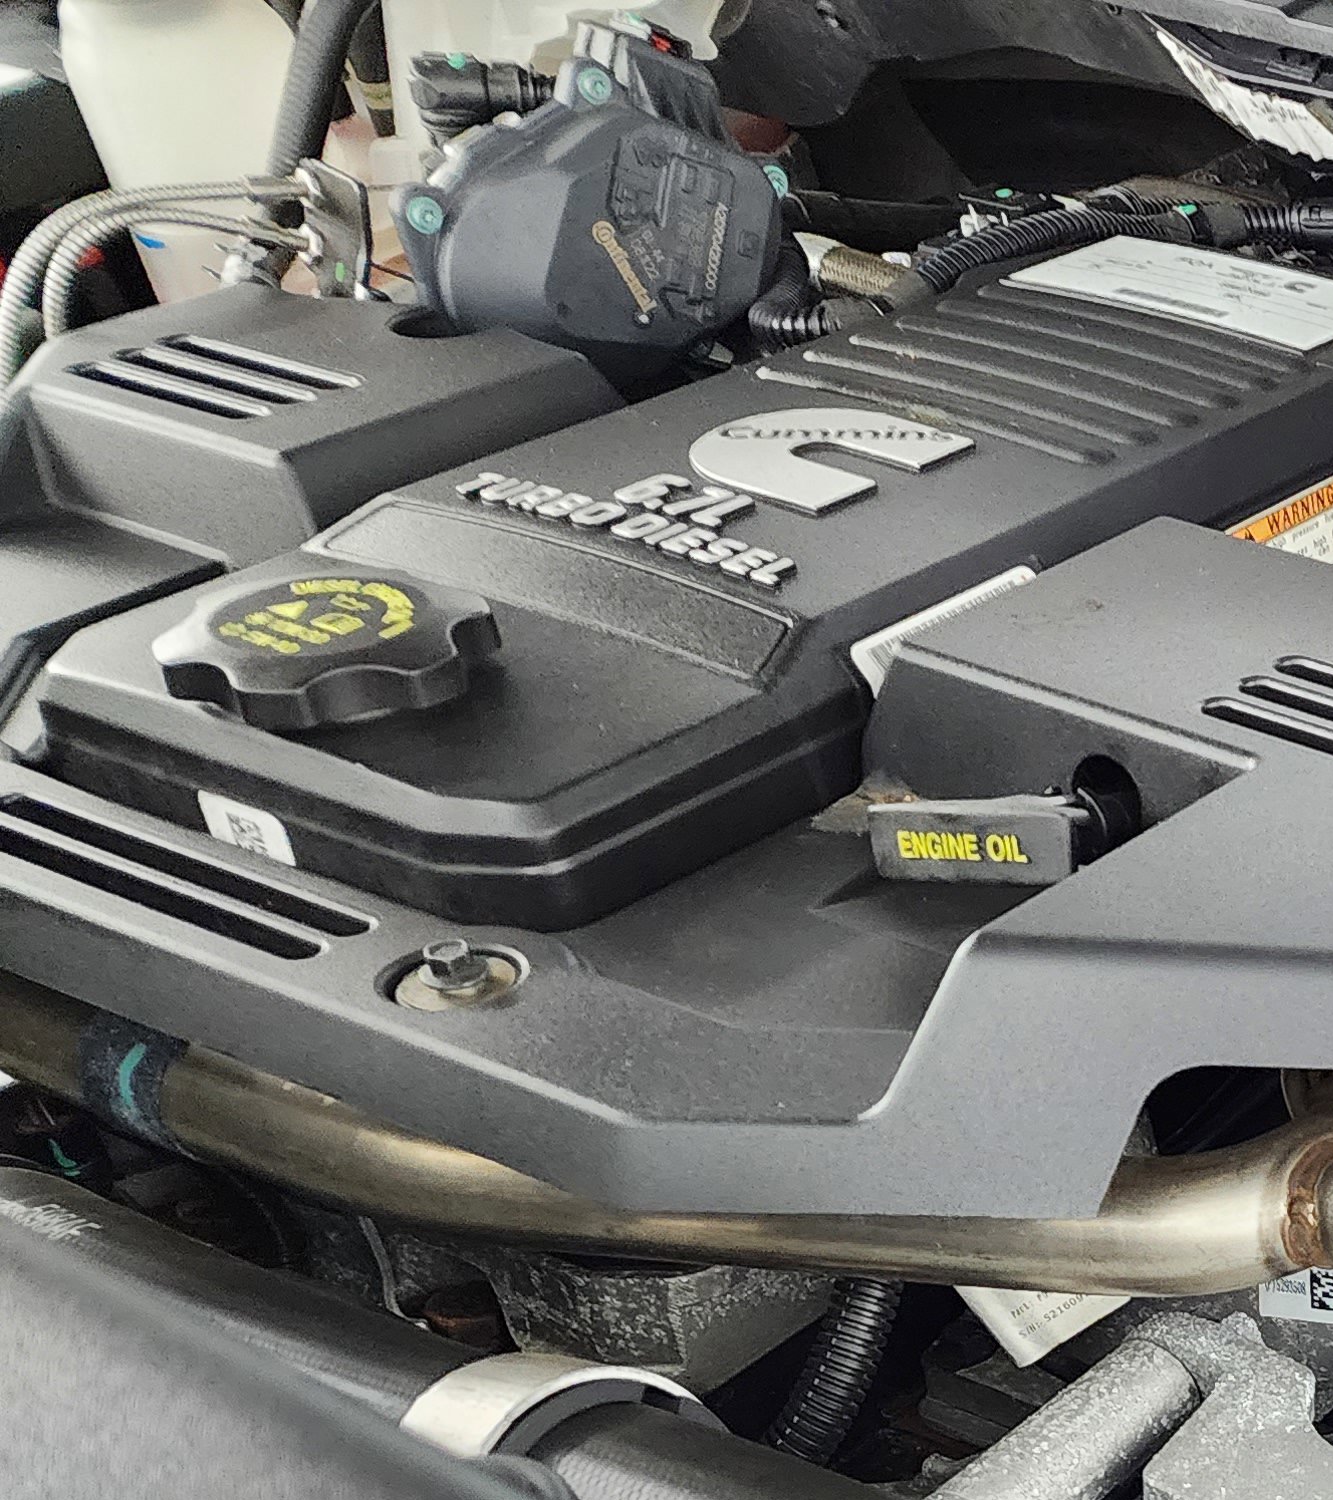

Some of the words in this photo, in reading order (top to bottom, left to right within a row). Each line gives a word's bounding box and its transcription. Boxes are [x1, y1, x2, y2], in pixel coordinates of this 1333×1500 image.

[614, 472, 756, 528] 6.7L
[455, 471, 627, 528] TURBO
[610, 513, 798, 588] DIESEL
[896, 829, 981, 862] ENGINE
[985, 834, 1030, 864] OIL
